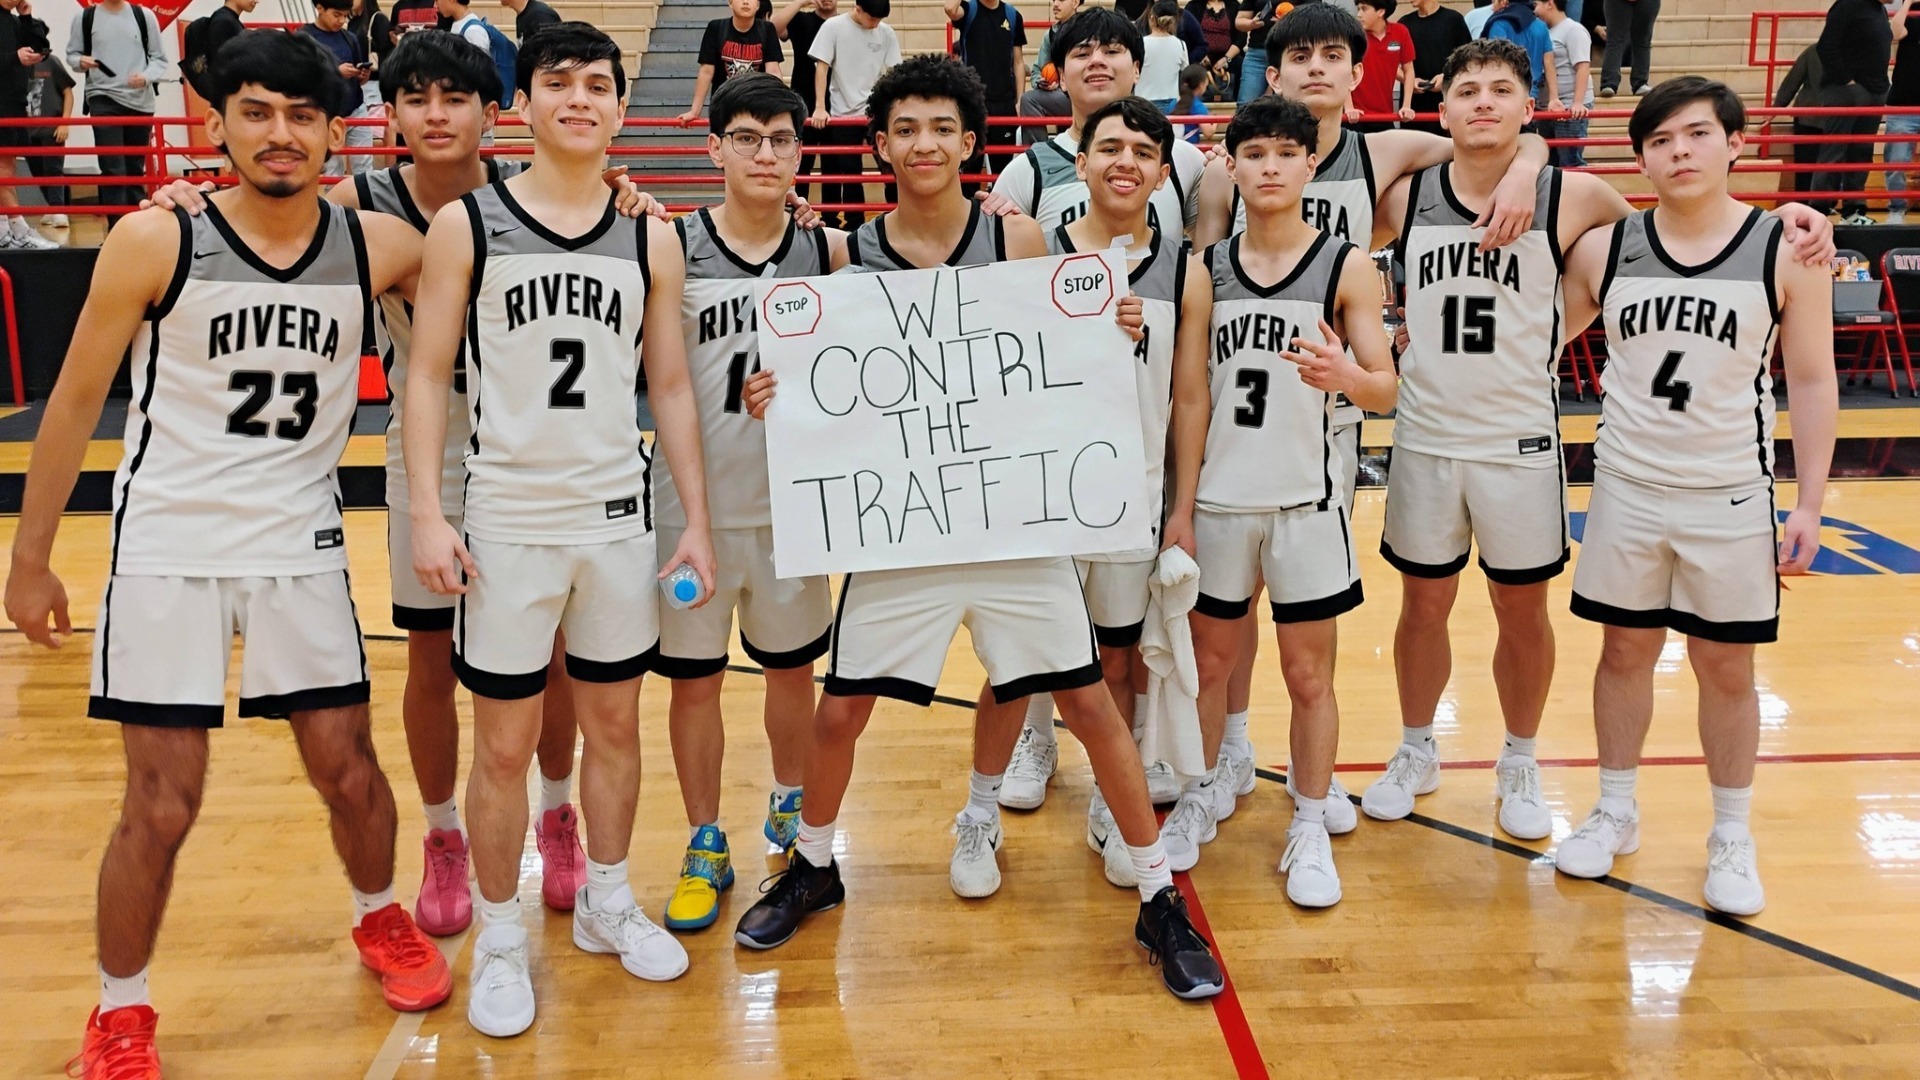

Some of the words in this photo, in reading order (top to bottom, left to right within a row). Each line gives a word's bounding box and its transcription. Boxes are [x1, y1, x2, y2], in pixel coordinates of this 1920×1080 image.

[1064, 272, 1105, 294] STOP
[1419, 241, 1520, 294] RIVERA
[504, 272, 622, 336] RIVERA
[775, 297, 808, 315] STOP
[876, 263, 992, 339] WE
[1440, 294, 1497, 355] 15
[1619, 295, 1738, 351] RIVERA
[208, 303, 339, 363] RIVERA
[1216, 313, 1300, 365] RIVERA
[547, 337, 587, 410] 2
[723, 351, 761, 414] 1
[810, 331, 1083, 416] CONTRL
[1234, 367, 1270, 430] 3
[1650, 350, 1693, 413] 4
[225, 369, 320, 442] 23
[882, 398, 992, 459] THE
[628, 502, 634, 511] S
[792, 441, 1127, 552] TRAFFIC
